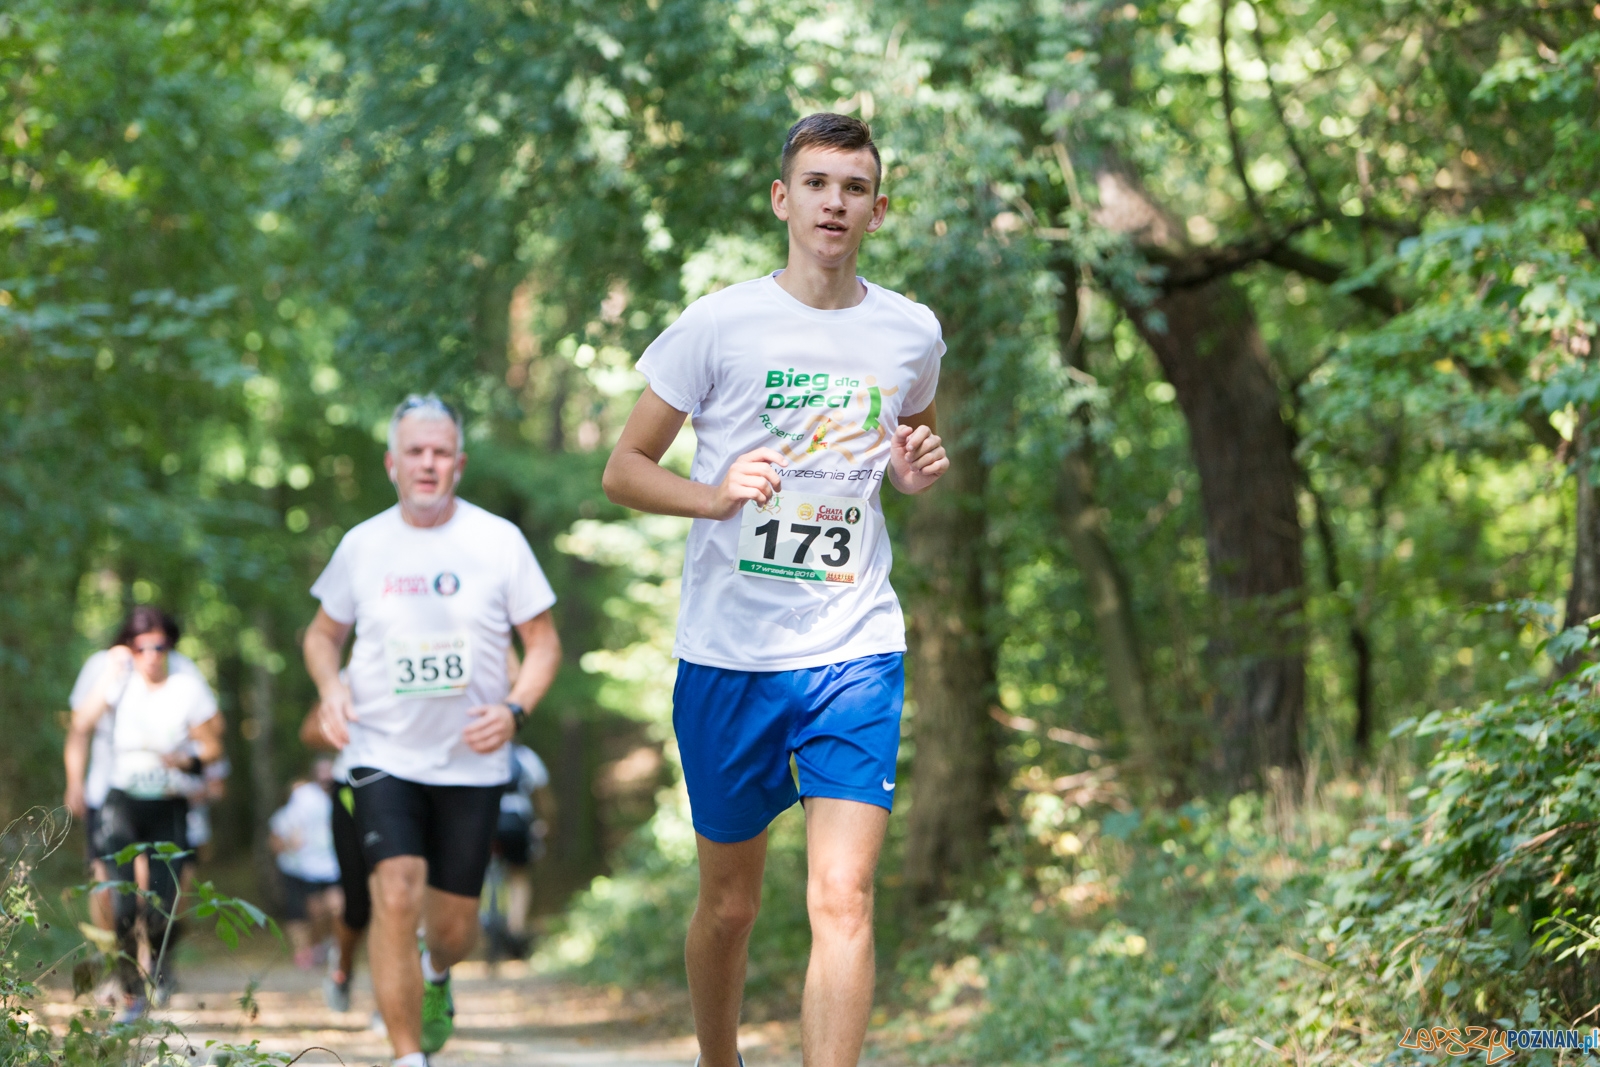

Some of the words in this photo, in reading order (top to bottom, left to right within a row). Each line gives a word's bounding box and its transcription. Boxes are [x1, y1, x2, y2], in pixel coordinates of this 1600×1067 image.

[765, 368, 829, 391] Bieg
[834, 377, 859, 387] dla
[765, 390, 853, 409] Dzieci
[848, 469, 884, 481] 2016
[815, 513, 844, 522] POLSKA
[819, 505, 843, 515] CHATA
[755, 519, 851, 567] 173
[750, 563, 762, 571] 17
[398, 654, 463, 683] 358
